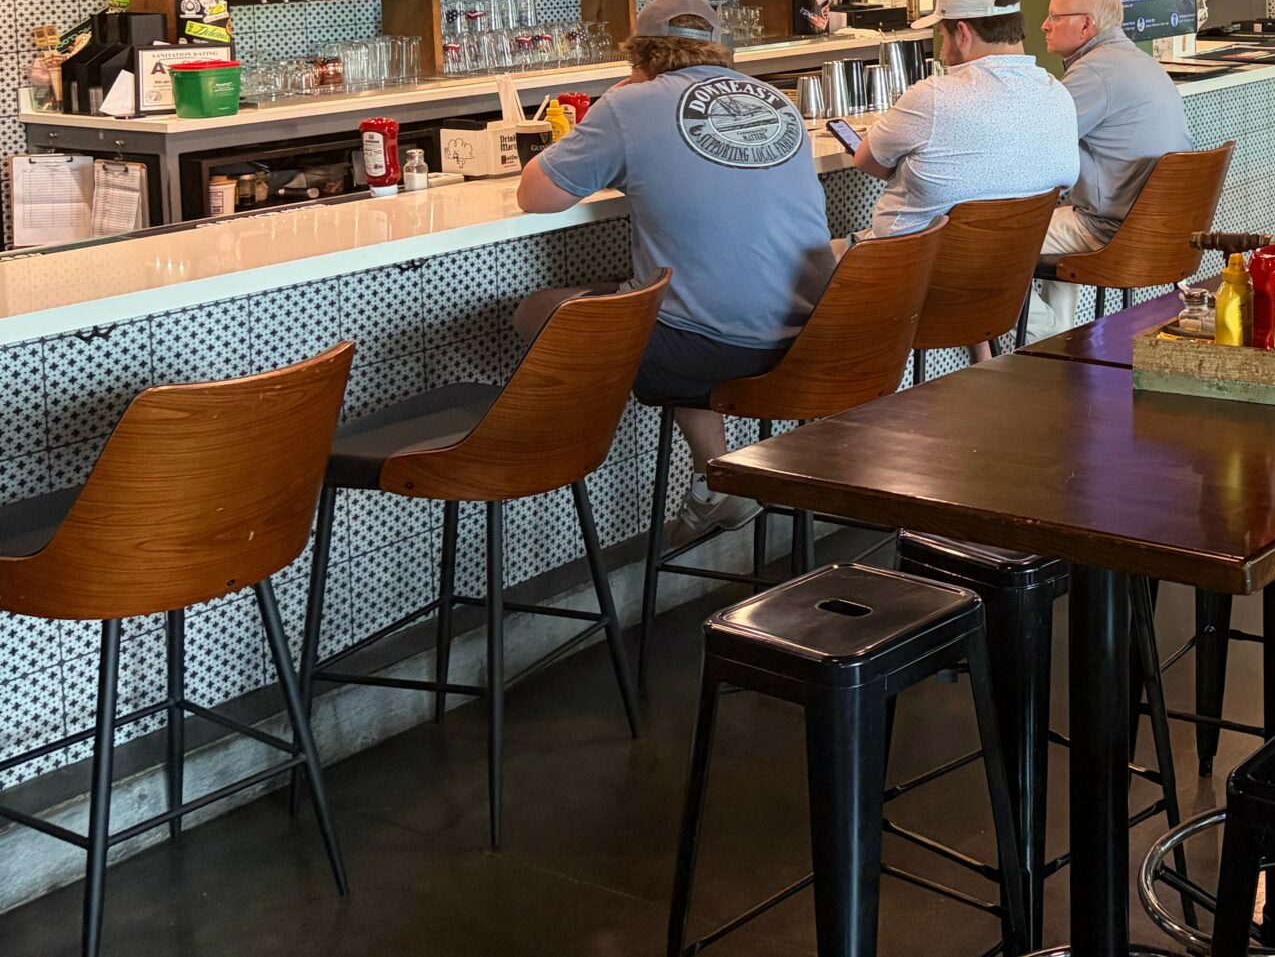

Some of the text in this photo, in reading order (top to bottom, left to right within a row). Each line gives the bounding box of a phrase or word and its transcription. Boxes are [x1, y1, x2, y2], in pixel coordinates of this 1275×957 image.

[151, 62, 167, 75] A
[689, 80, 780, 114] DOWNEAST
[697, 134, 750, 162] SUPPORTING
[751, 145, 778, 163] LOCAL
